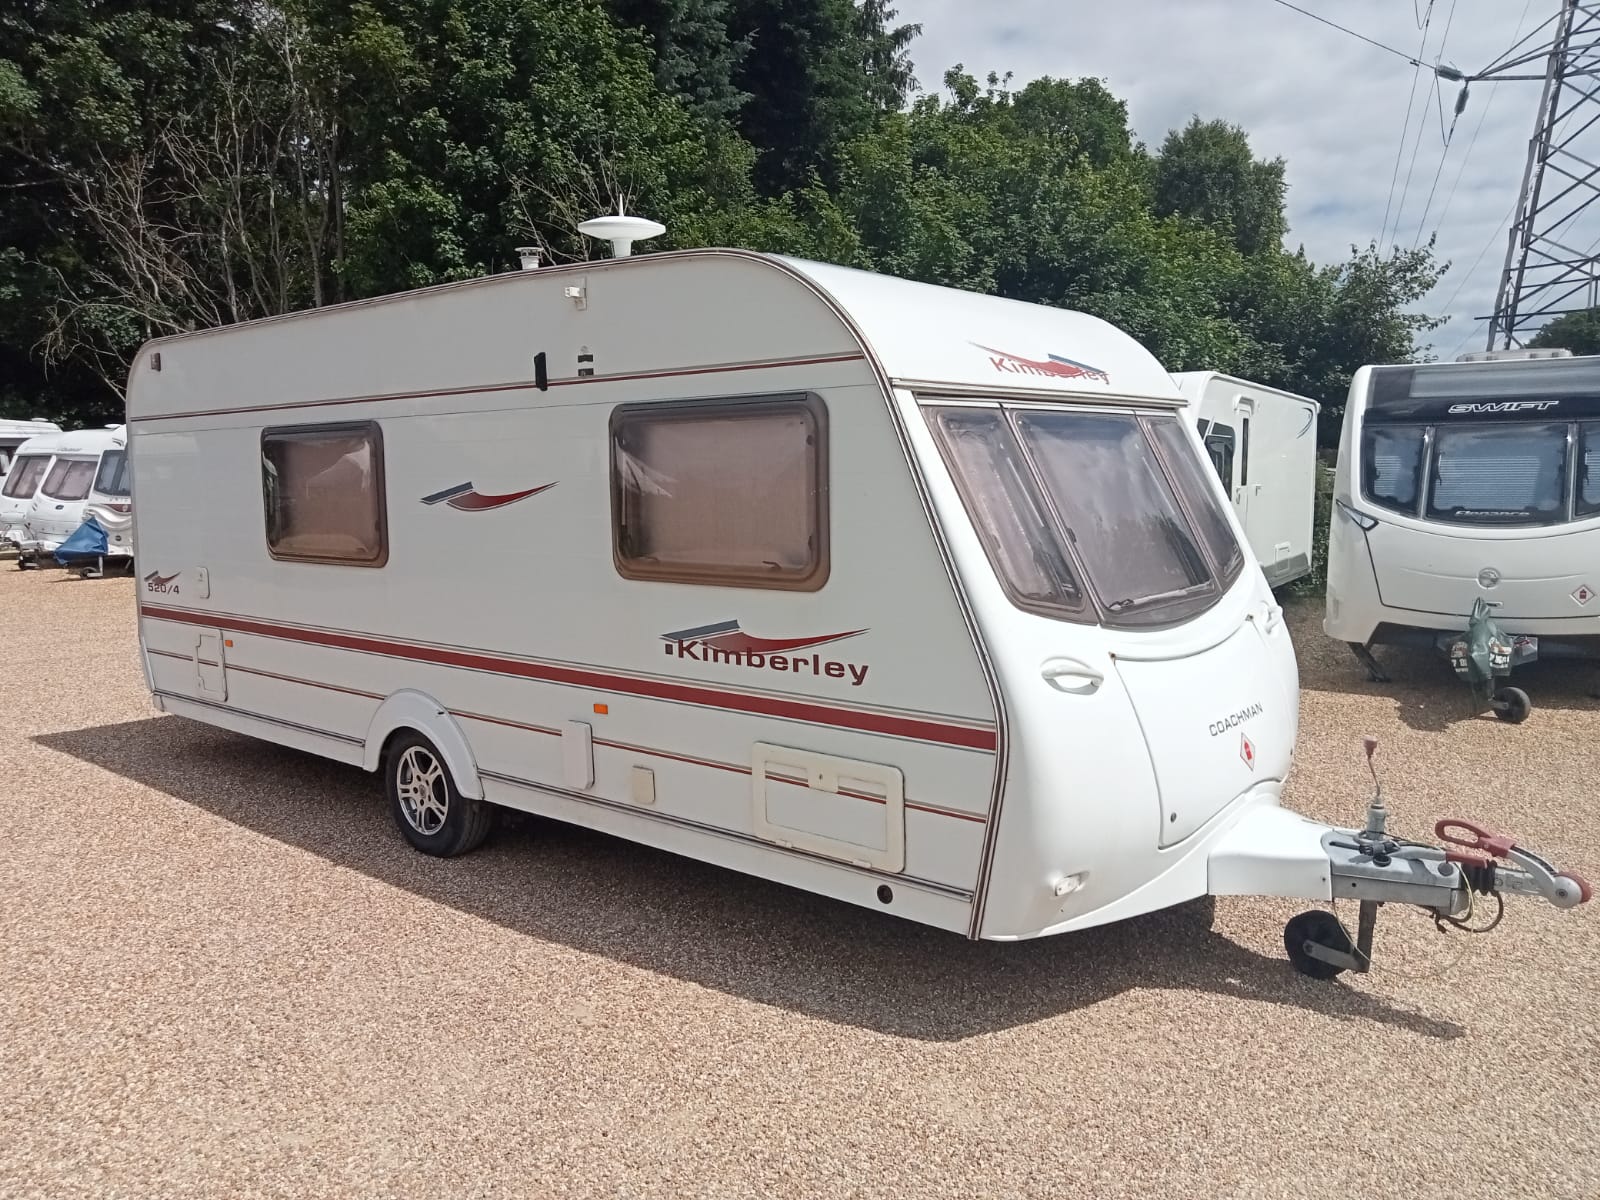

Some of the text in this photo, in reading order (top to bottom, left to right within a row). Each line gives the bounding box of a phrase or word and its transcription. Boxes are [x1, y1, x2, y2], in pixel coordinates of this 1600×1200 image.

[988, 356, 1110, 385] Kimley
[1448, 400, 1560, 413] SWIFT
[147, 582, 180, 595] 520/4
[677, 639, 869, 686] Kimberley
[1208, 701, 1264, 737] COACHMAN
